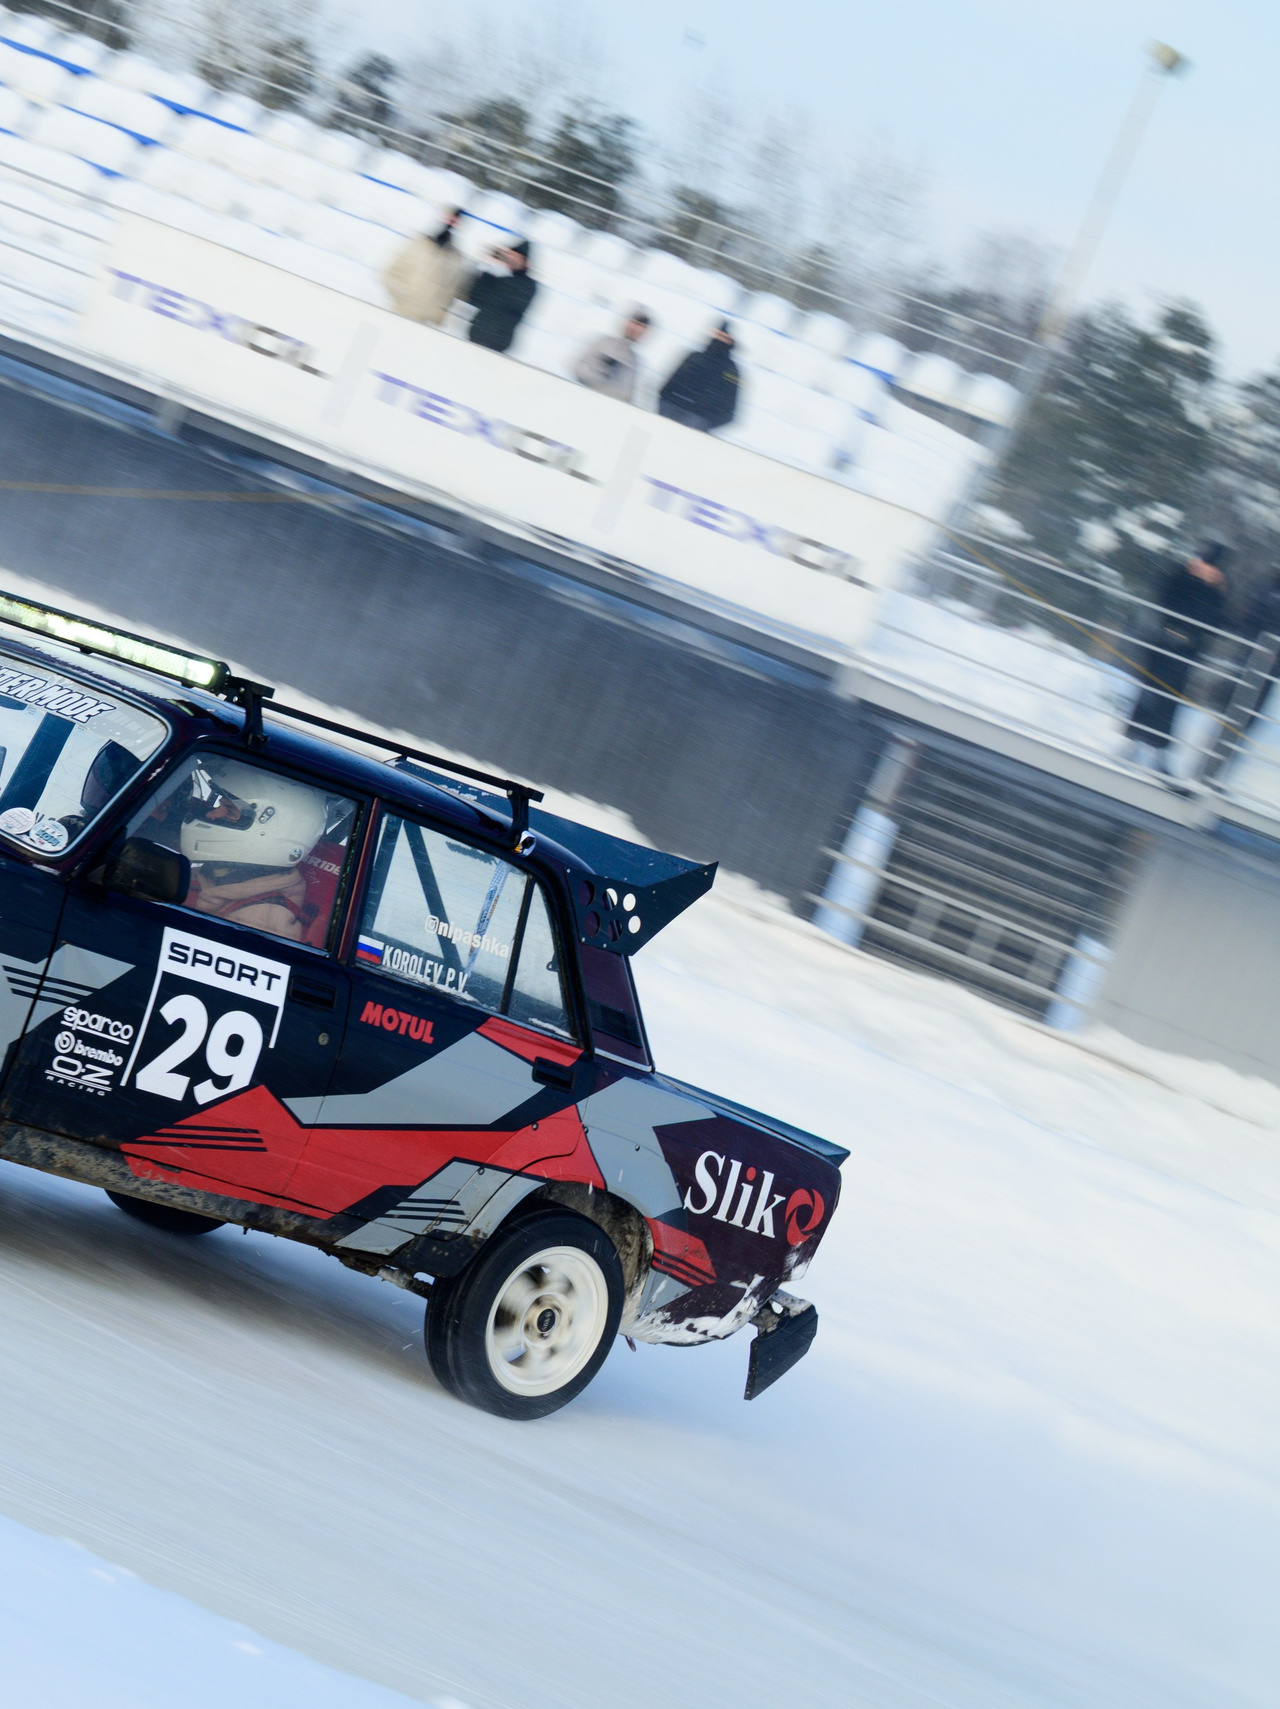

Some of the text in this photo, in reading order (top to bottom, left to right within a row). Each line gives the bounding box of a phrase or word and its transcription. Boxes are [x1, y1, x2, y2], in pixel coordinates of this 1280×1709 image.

[25, 685, 117, 724] MODE
[303, 855, 342, 876] RIDE
[168, 941, 281, 992] SPORT
[382, 945, 443, 985] KOROLEV
[63, 1006, 134, 1039] sparco
[359, 1001, 435, 1045] MOTUL
[73, 1039, 123, 1066] brembo
[136, 994, 263, 1105] 29
[46, 1075, 105, 1096] RACING
